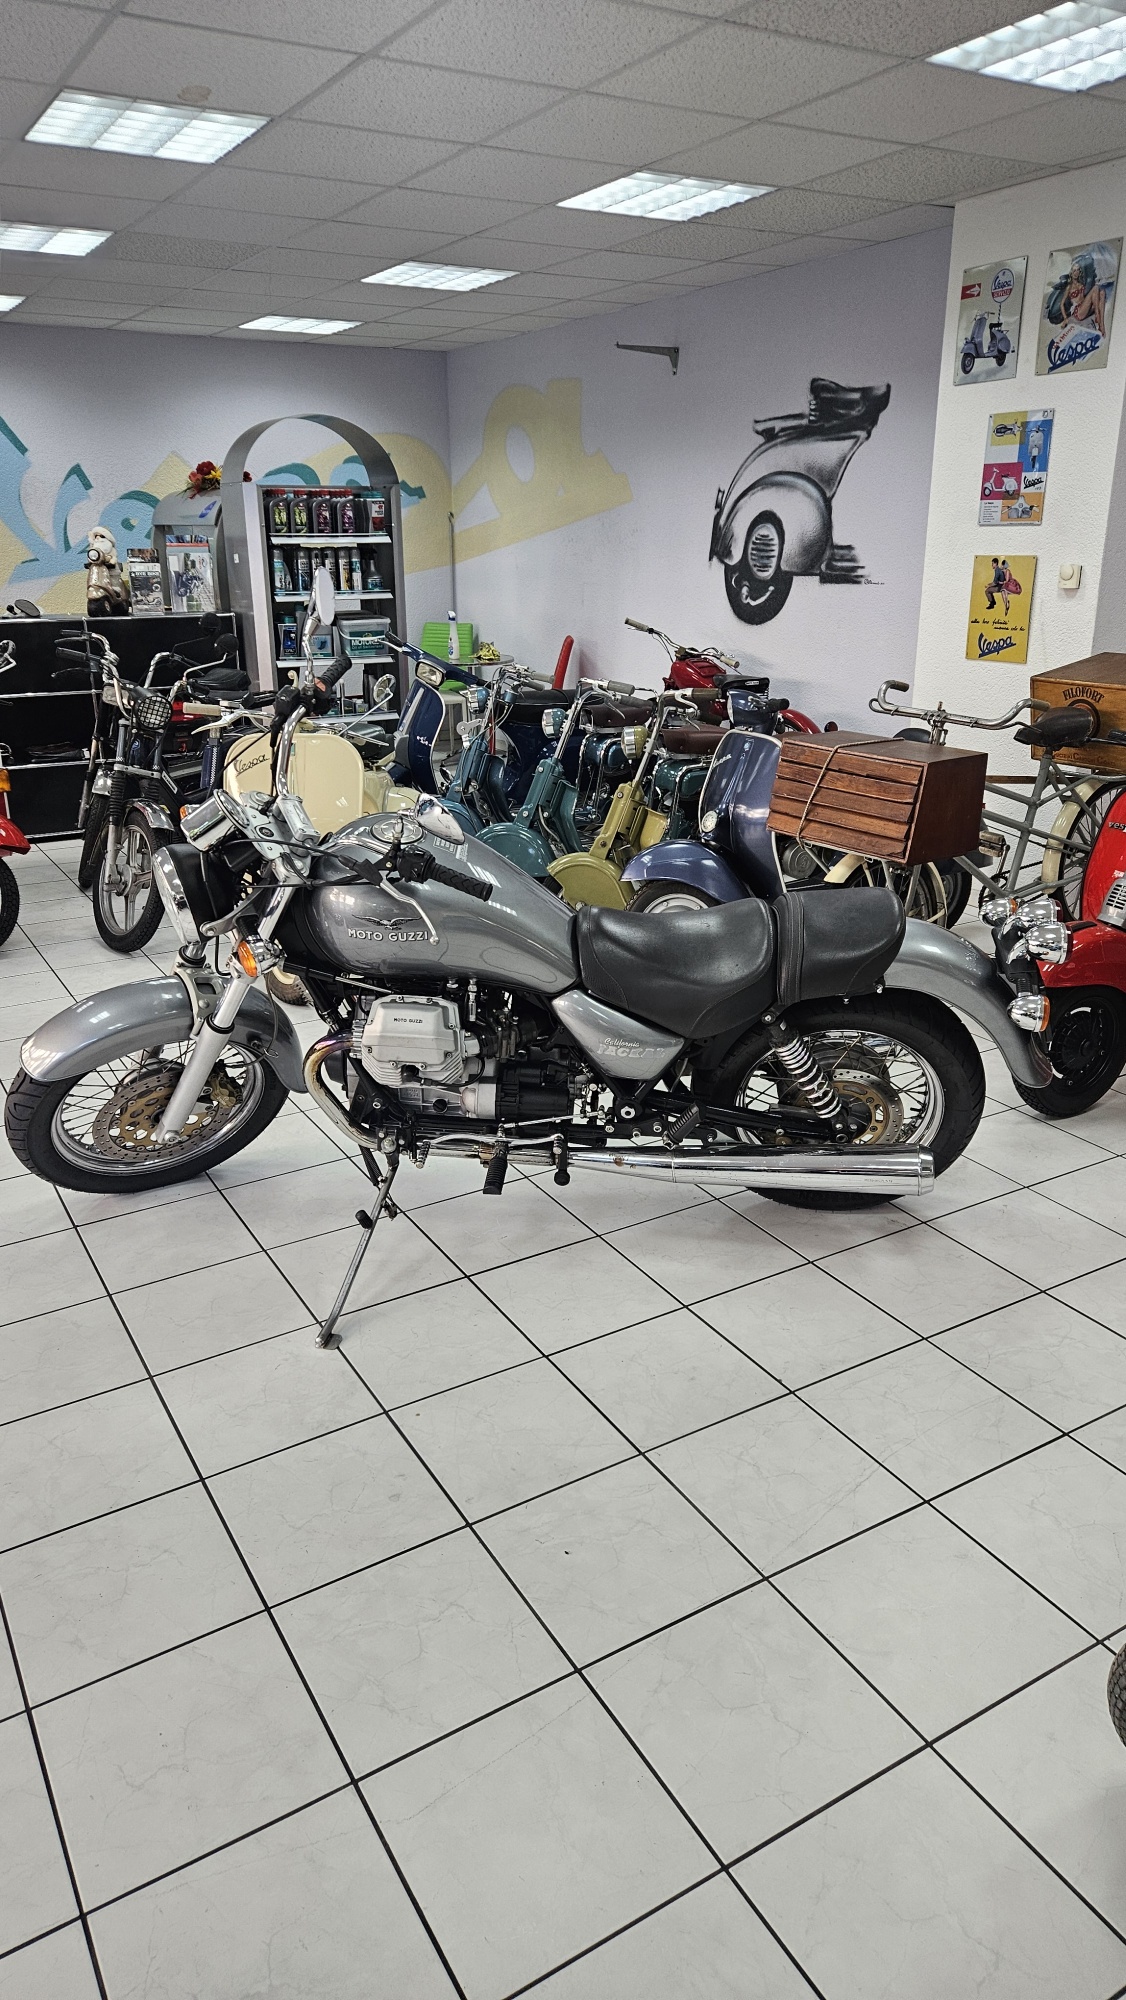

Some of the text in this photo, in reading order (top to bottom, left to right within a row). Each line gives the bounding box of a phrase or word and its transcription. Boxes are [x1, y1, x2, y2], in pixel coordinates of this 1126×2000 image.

[1047, 335, 1101, 374] Vespa
[1023, 475, 1044, 489] Vespa
[978, 632, 1017, 658] Vespa
[1062, 686, 1105, 704] FILOFORT
[233, 754, 270, 777] Vespa
[1108, 821, 1126, 831] ves
[348, 928, 428, 942] MOTO GUZZI
[604, 1037, 640, 1049] California
